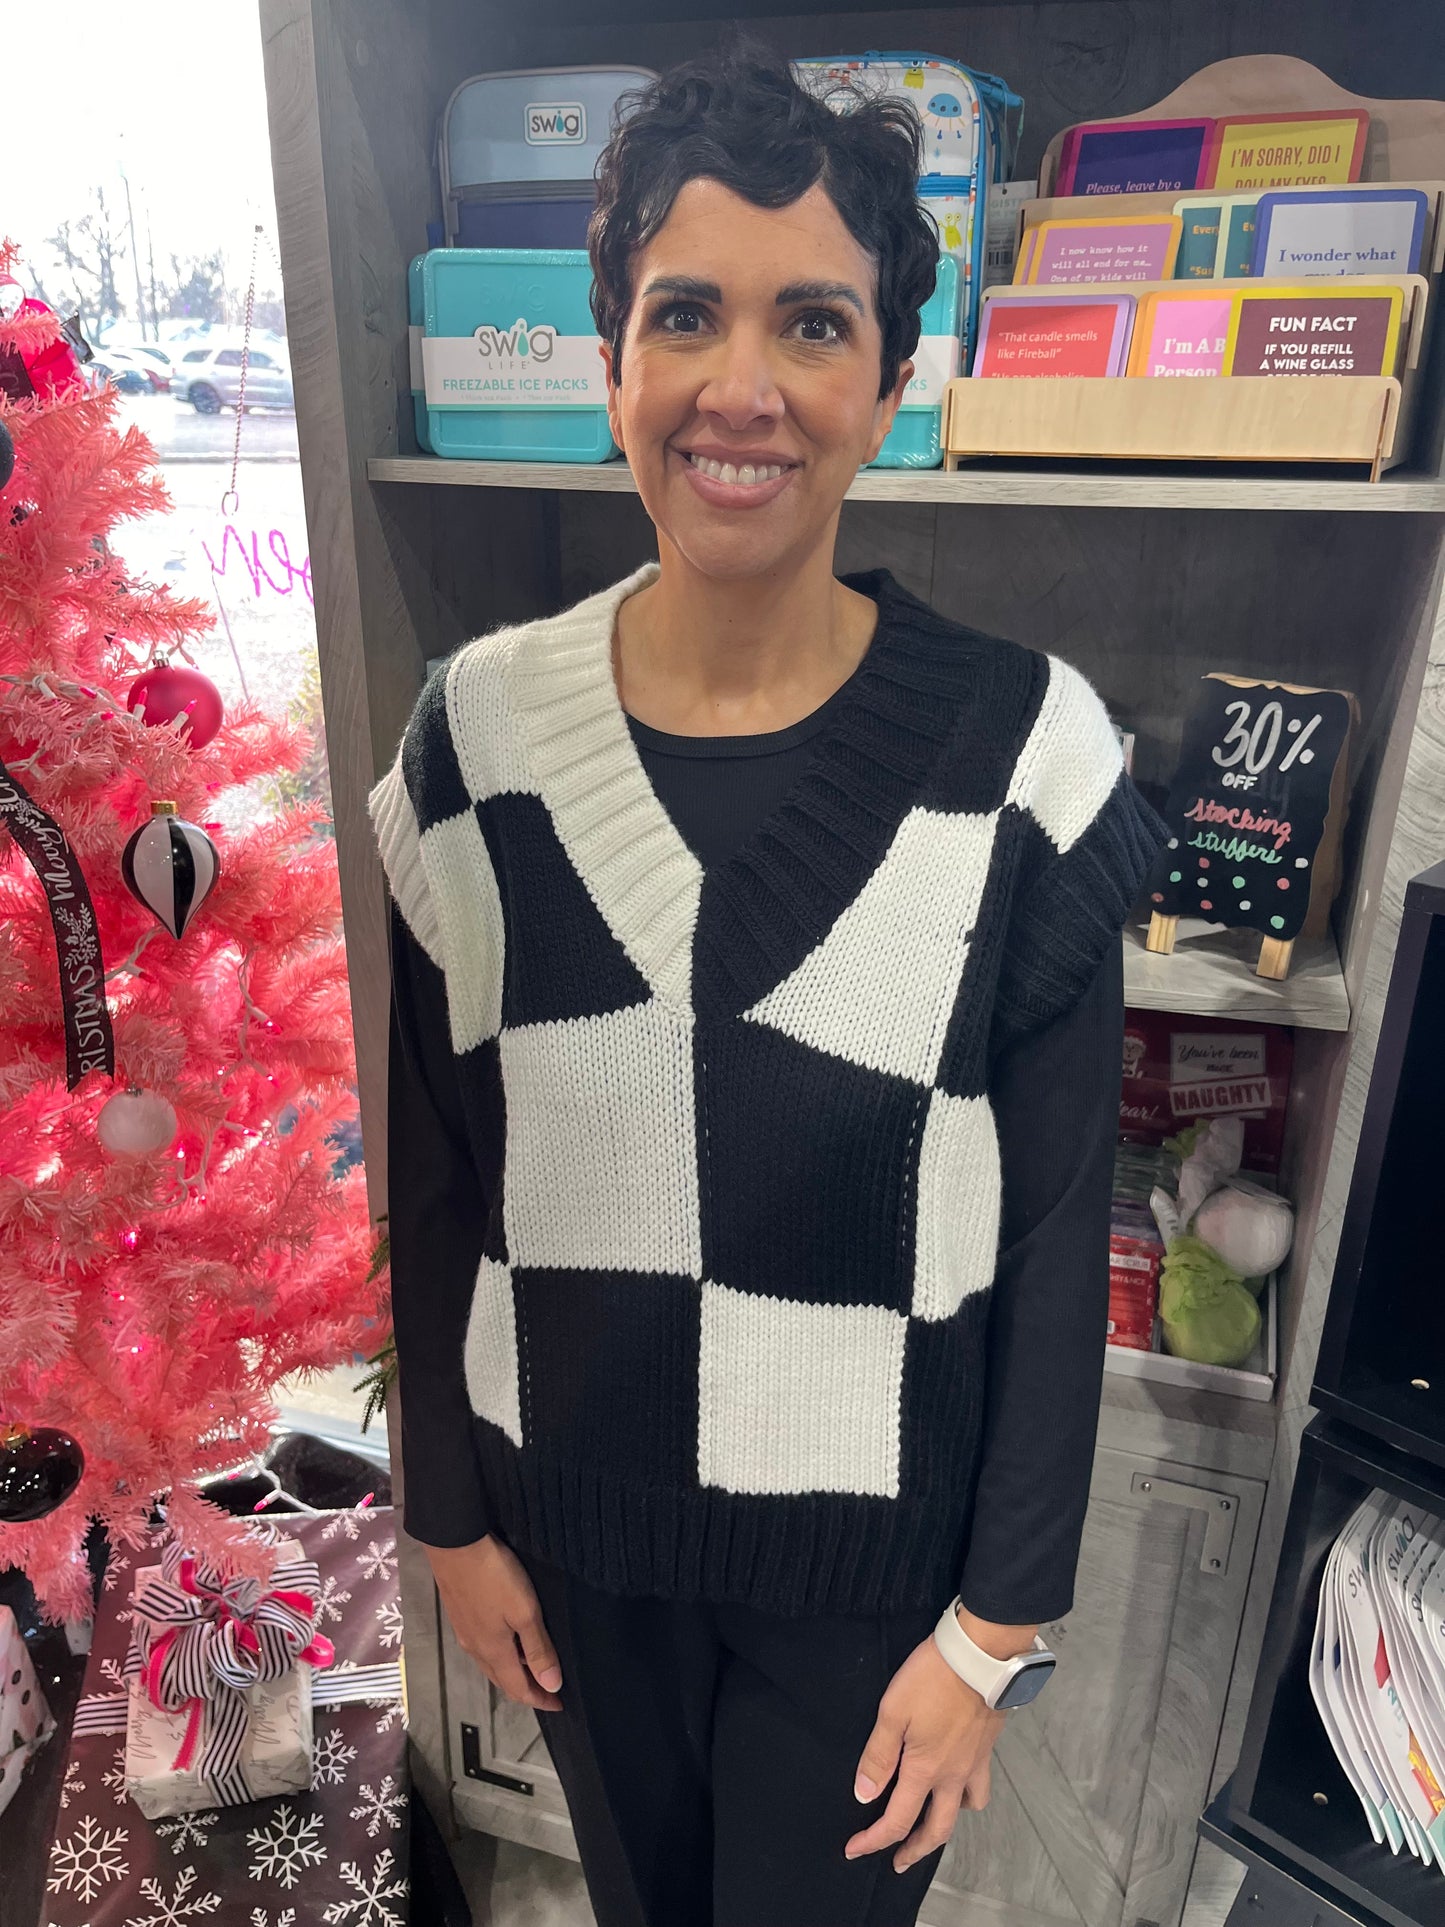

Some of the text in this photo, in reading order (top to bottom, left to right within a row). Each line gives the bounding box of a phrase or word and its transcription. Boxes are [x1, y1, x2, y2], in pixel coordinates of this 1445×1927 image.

[530, 109, 580, 137] swig
[1231, 144, 1341, 168] I'M SORRY, DID I
[1085, 181, 1123, 195] Please,
[1125, 180, 1155, 193] leave
[1069, 247, 1087, 255] now
[1090, 245, 1114, 255] know
[1117, 244, 1135, 254] how
[1137, 244, 1149, 253] it
[1278, 246, 1397, 263] I wonder what
[1052, 259, 1073, 270] will
[1075, 259, 1090, 269] all
[1093, 258, 1111, 268] end
[1114, 258, 1130, 267] for
[1070, 273, 1082, 283] of
[1101, 271, 1122, 281] kids
[1125, 271, 1147, 281] will
[1268, 315, 1358, 333] FUN FACT
[478, 322, 554, 363] swig
[1028, 330, 1063, 343] candle
[1065, 329, 1098, 342] smells
[996, 348, 1016, 360] like
[1163, 337, 1193, 355] I'm
[1195, 337, 1210, 354] A
[1264, 343, 1354, 356] IF YOU REFILL
[1258, 358, 1355, 370] A WINE GLASS
[442, 378, 590, 392] FREEZABLE ICE PACKS
[1211, 700, 1322, 774] 30%
[1221, 771, 1258, 791] OFF
[1183, 797, 1292, 850] stocking
[1186, 831, 1283, 864] stuffers
[70, 963, 107, 1080] RISTMAS
[1172, 1081, 1268, 1112] NAUGHTY
[1119, 1100, 1160, 1120] ear!
